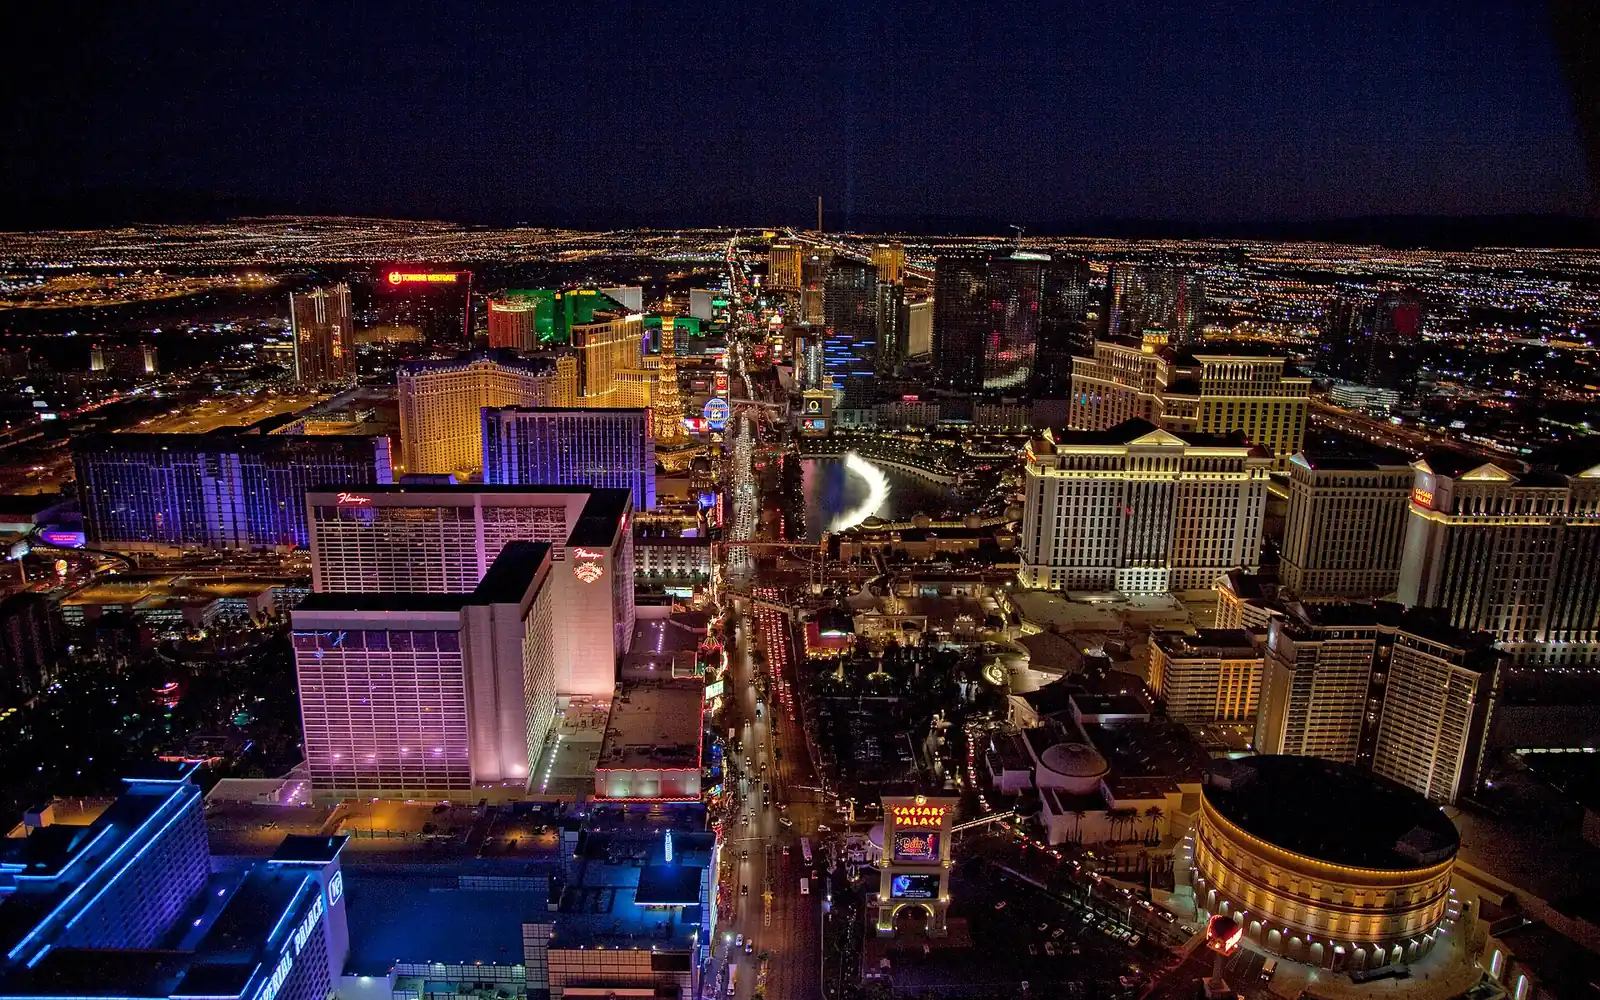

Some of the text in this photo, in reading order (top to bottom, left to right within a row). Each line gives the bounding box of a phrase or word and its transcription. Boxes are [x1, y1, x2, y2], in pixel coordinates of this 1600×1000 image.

[893, 807, 945, 816] CAESARS
[896, 817, 942, 825] PALACE
[293, 894, 324, 956] PALACE
